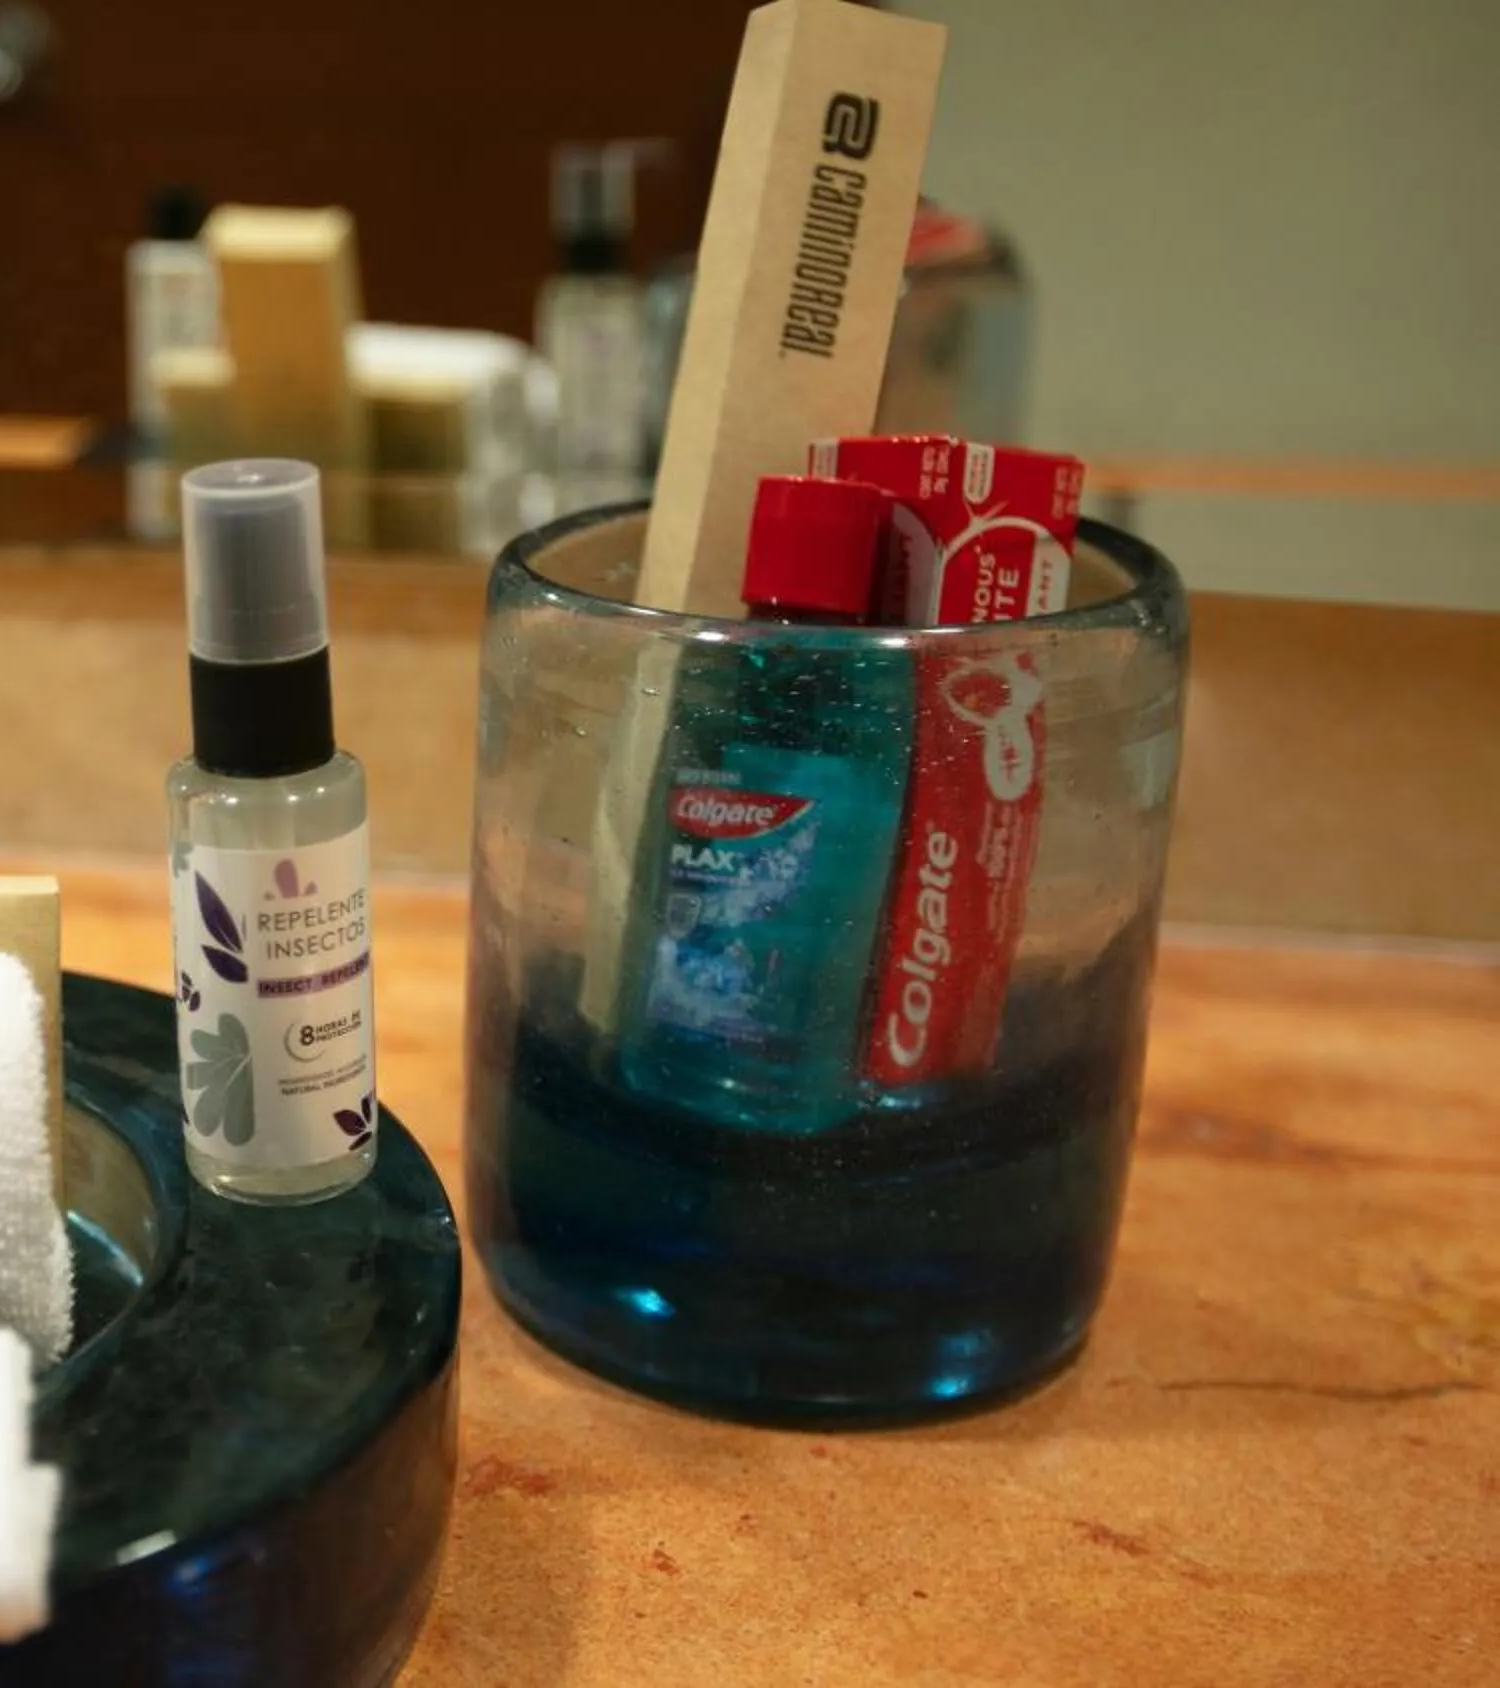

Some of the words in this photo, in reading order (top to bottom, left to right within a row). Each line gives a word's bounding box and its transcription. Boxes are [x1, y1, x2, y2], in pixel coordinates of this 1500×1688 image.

[971, 553, 997, 623] NOUS
[994, 567, 1020, 621] ITE
[677, 793, 774, 828] Colgate
[671, 843, 735, 872] PLAX
[258, 888, 365, 933] REPELENTE
[266, 916, 365, 960] INSECTOS
[887, 831, 958, 1067] Colgate
[259, 977, 312, 994] INSECT
[300, 1025, 315, 1046] 8
